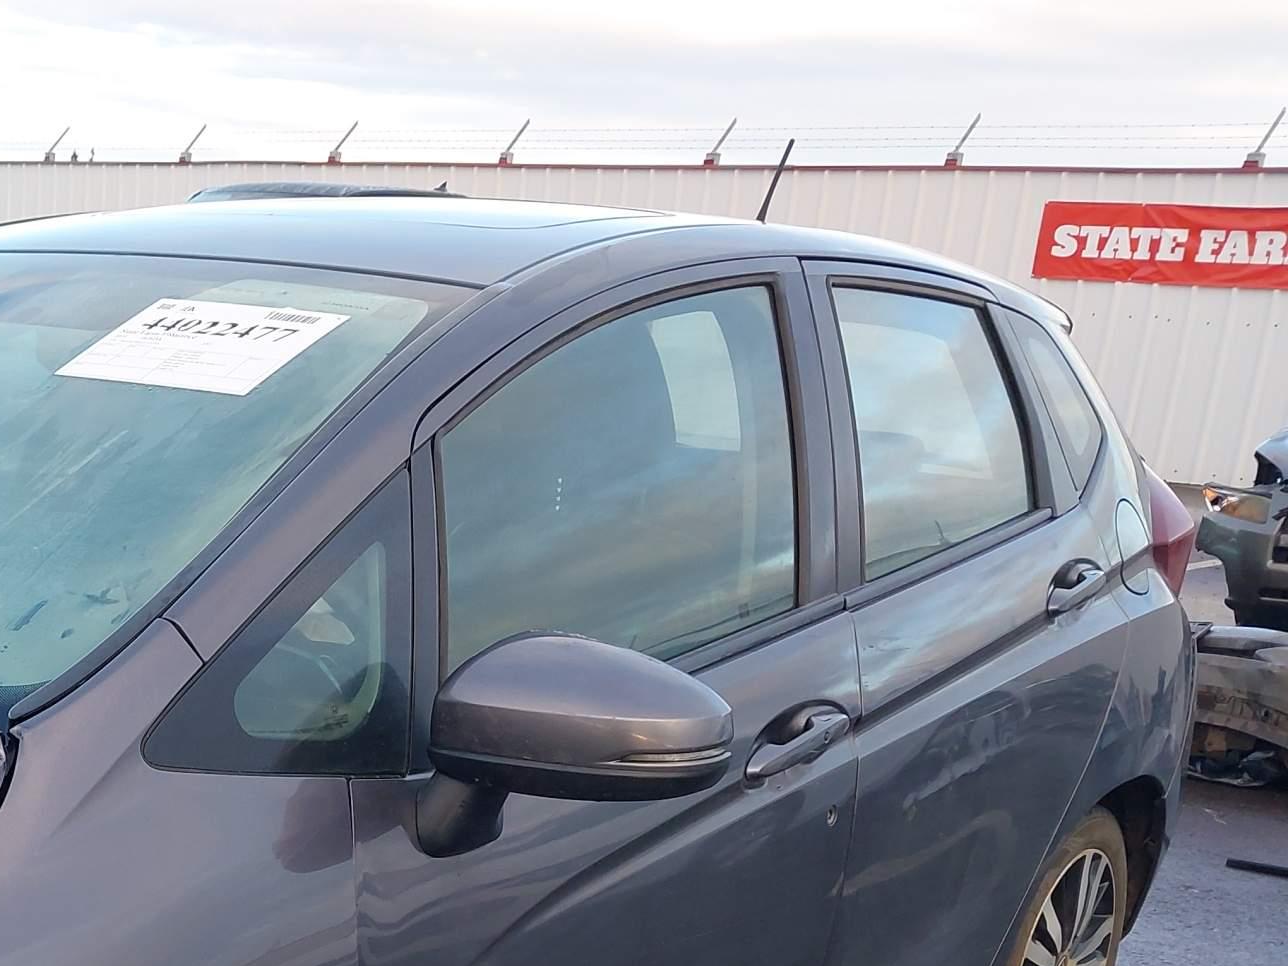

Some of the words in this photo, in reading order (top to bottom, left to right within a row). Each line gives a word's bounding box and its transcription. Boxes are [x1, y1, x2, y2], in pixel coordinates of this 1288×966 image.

[1051, 224, 1190, 262] STATE
[1194, 229, 1288, 265] FAR
[142, 316, 299, 342] 44022477
